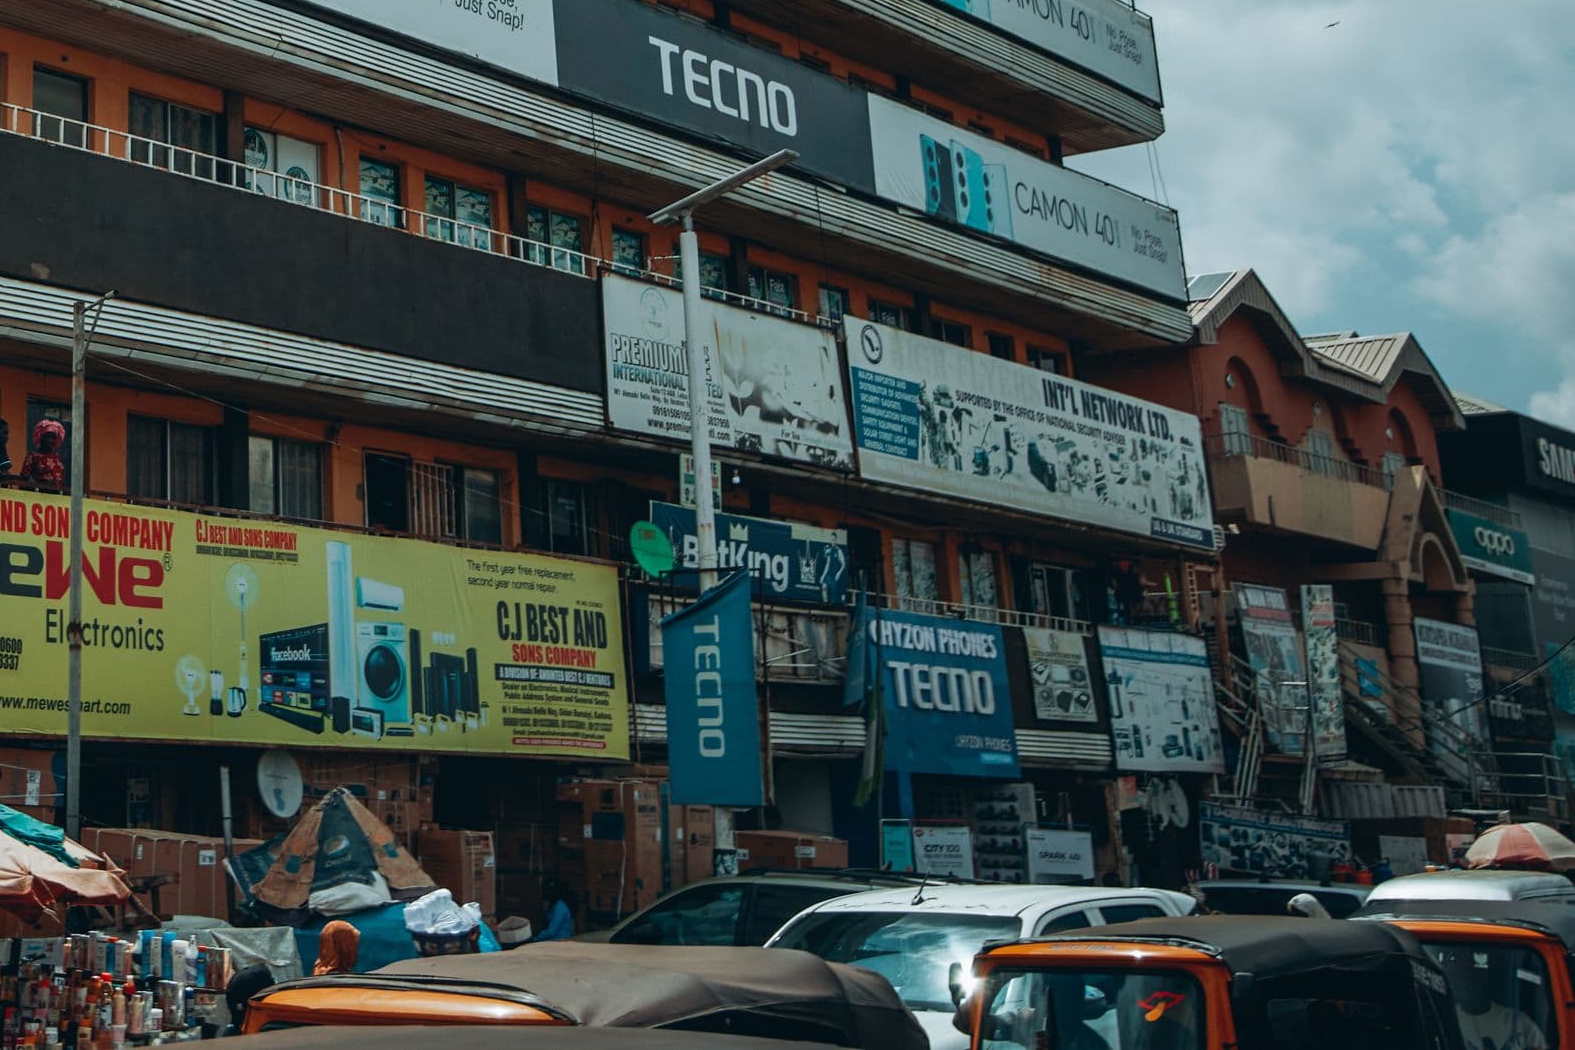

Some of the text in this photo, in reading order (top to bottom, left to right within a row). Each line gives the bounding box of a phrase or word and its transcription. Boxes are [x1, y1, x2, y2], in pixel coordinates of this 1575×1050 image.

[486, 2, 524, 32] Snap!
[1070, 7, 1090, 40] 40
[648, 35, 798, 137] TECNO
[1015, 182, 1114, 246] CAMON 40
[612, 363, 686, 391] INTERNATIONAL
[955, 389, 1102, 439] SUPPORTED BY THE OFFICE OF NATIONAL SECURITY
[1042, 378, 1174, 442] INT'L NETWORK LTD.
[1537, 436, 1575, 484] SAM
[31, 502, 70, 539] SON
[86, 509, 174, 552] COMPANY
[210, 525, 227, 544] BEST
[229, 527, 242, 546] AND
[244, 529, 263, 547] SONS
[264, 530, 297, 551] COMPANY
[1475, 526, 1515, 557] oppo
[467, 559, 532, 576] The first year free
[683, 534, 789, 592] BtKing
[467, 576, 493, 587] second
[494, 579, 510, 589] year
[512, 581, 535, 591] normal
[496, 600, 607, 649] C.J BEST AND
[937, 627, 998, 660] PHONES
[270, 643, 311, 661] facebook
[512, 643, 596, 668] SONS COMPANY
[693, 614, 726, 758] TECNO
[887, 660, 995, 715] TECNO
